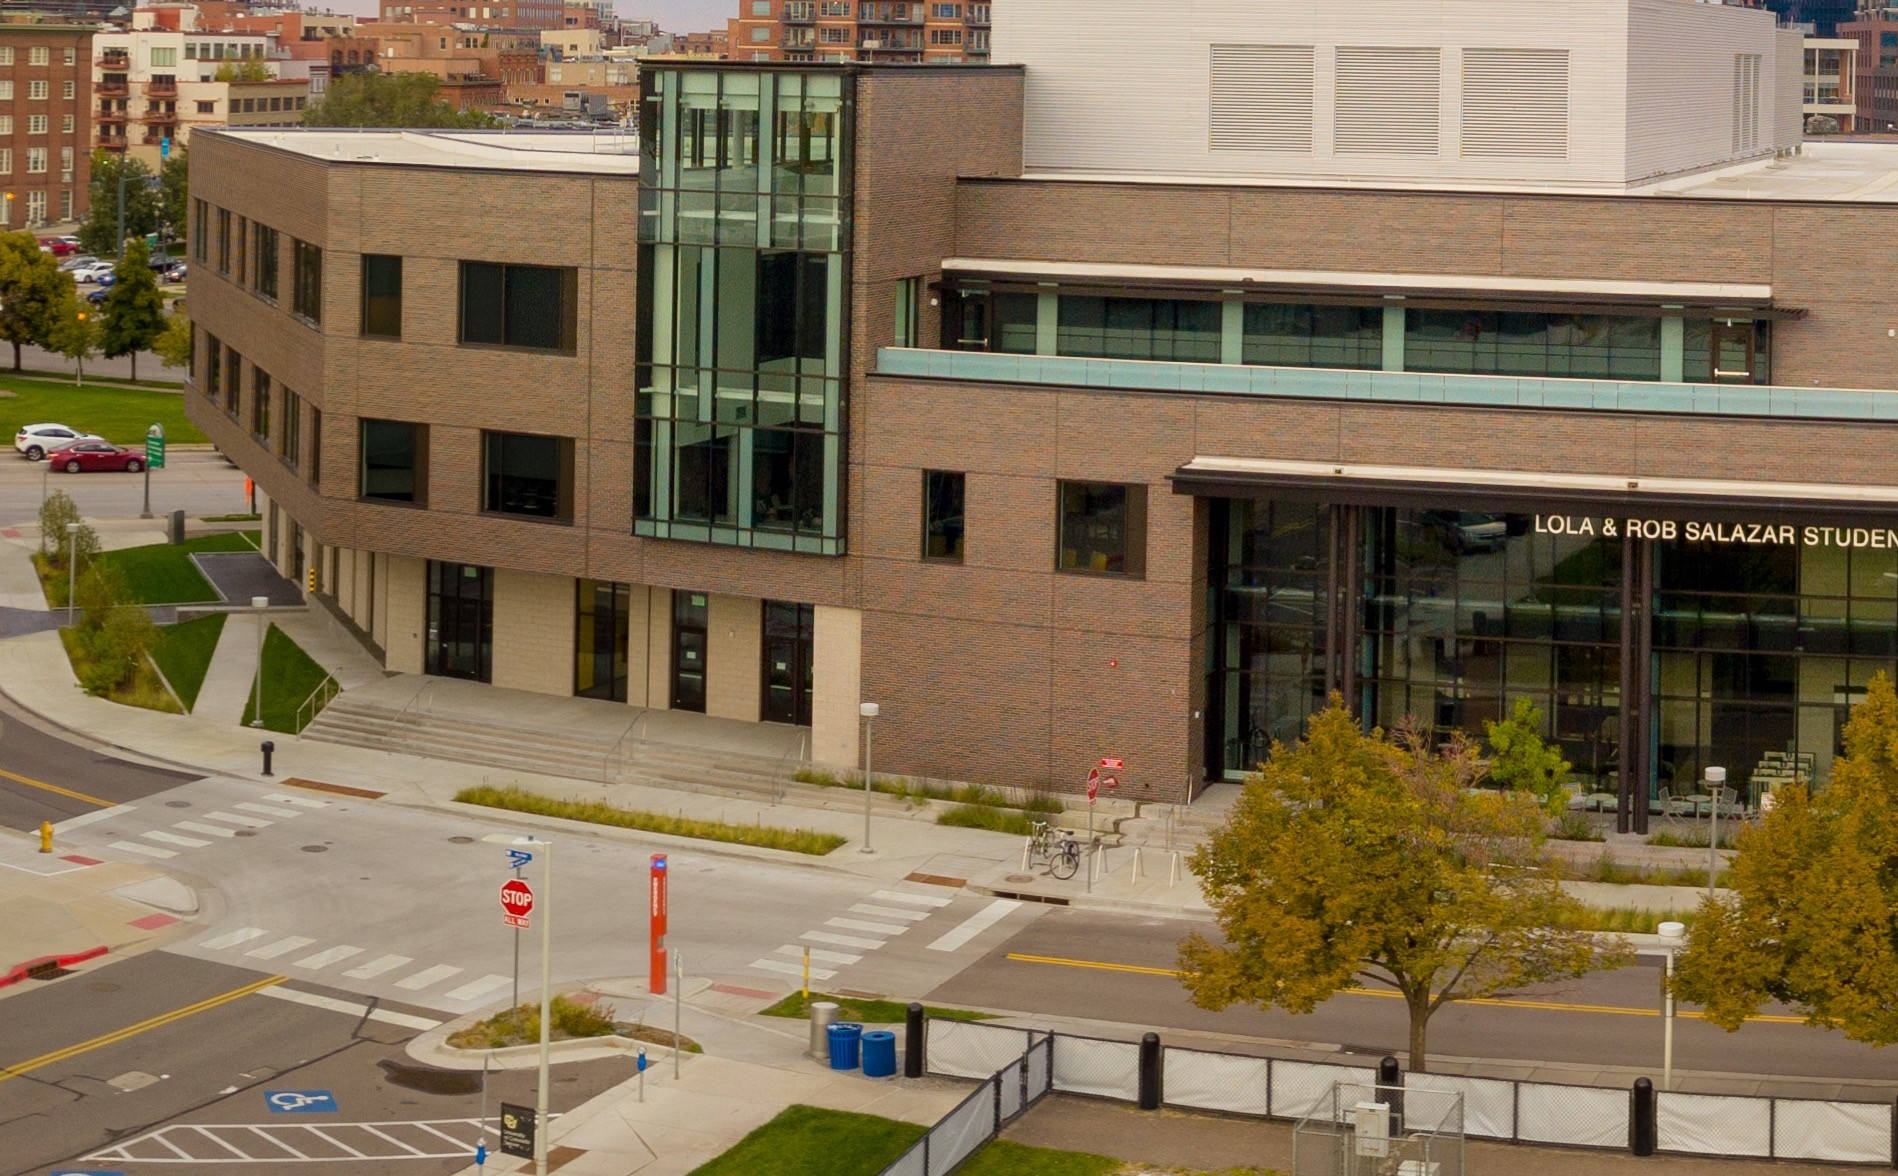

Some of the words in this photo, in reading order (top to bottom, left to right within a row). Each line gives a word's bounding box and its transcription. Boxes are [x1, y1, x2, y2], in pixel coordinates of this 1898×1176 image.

[1535, 514, 1594, 535] LOLA
[1602, 518, 1618, 537] &
[1626, 519, 1677, 539] ROB
[1685, 522, 1795, 545] SALAZAR
[502, 889, 532, 907] STOP
[504, 915, 515, 925] ALL
[516, 917, 529, 927] WAY
